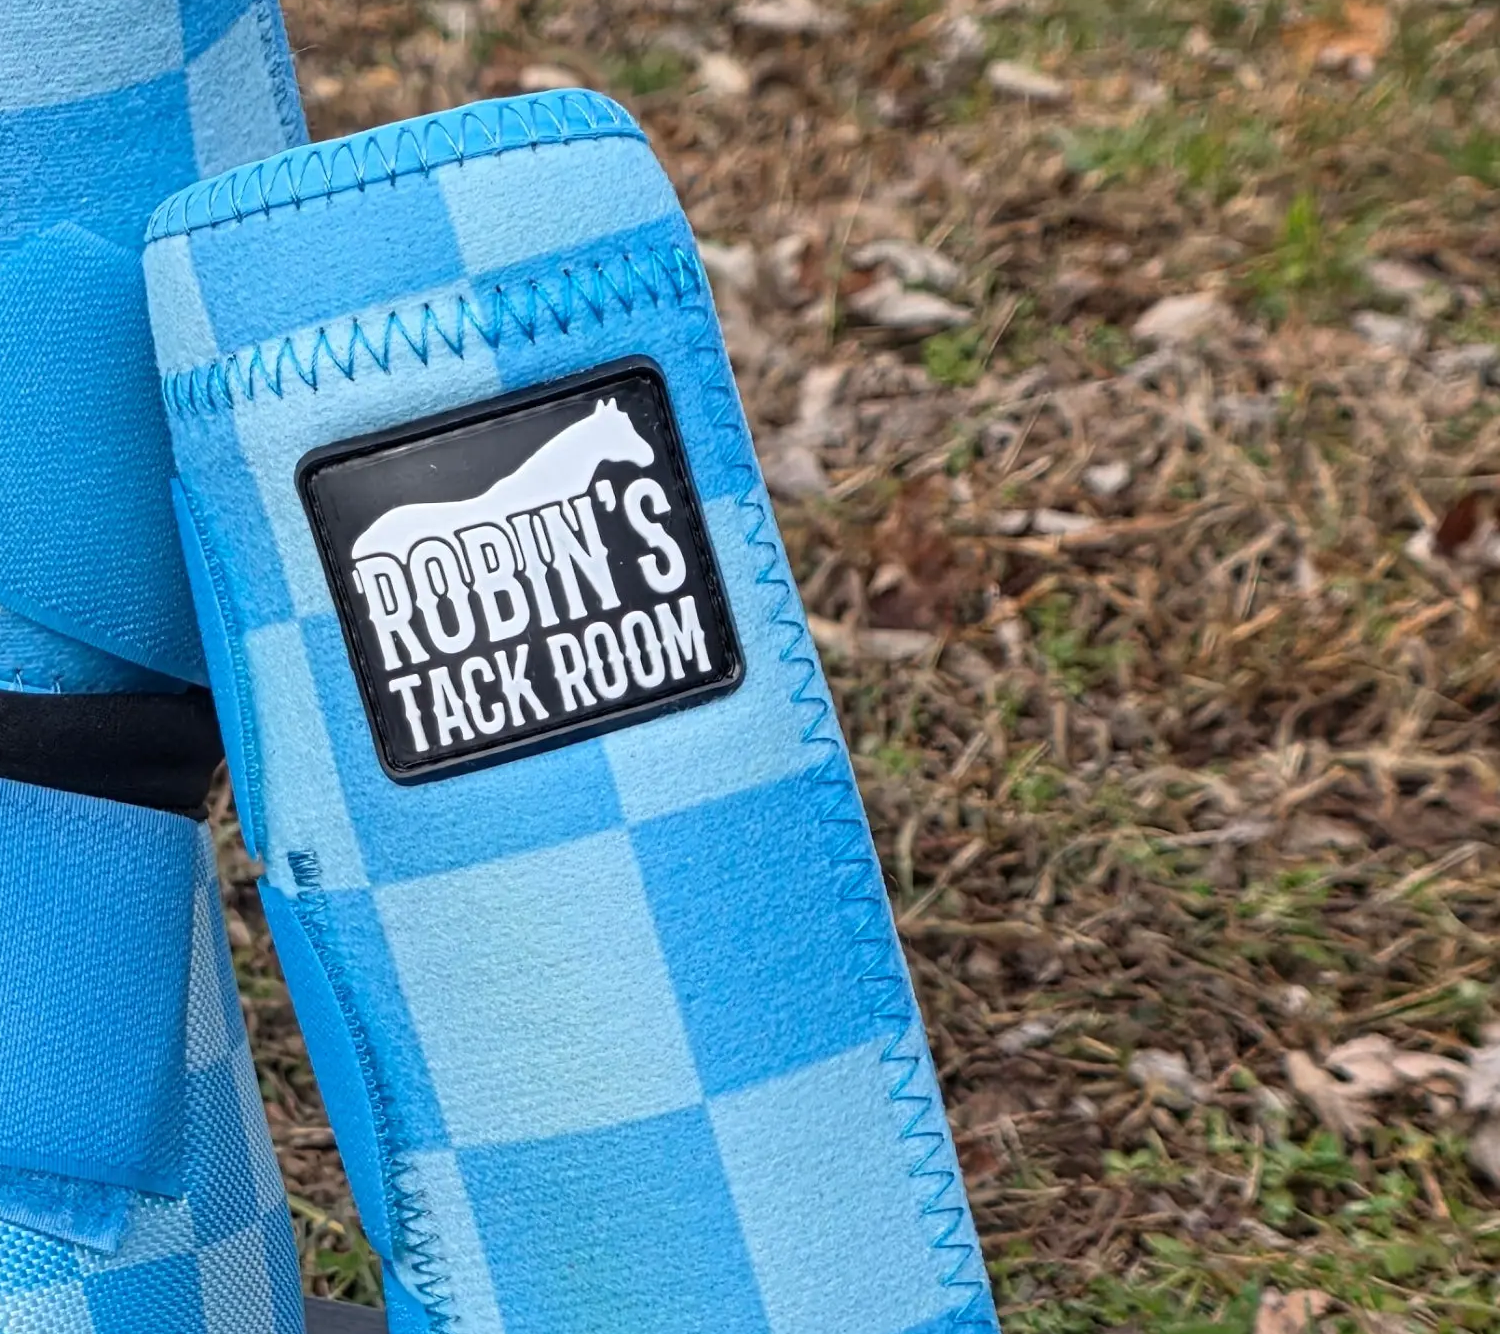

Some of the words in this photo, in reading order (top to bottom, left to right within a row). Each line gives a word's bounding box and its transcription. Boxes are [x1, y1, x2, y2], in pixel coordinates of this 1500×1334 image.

[354, 477, 687, 671] ROBIN'S
[389, 643, 550, 752] TACK
[546, 595, 713, 712] ROOM
